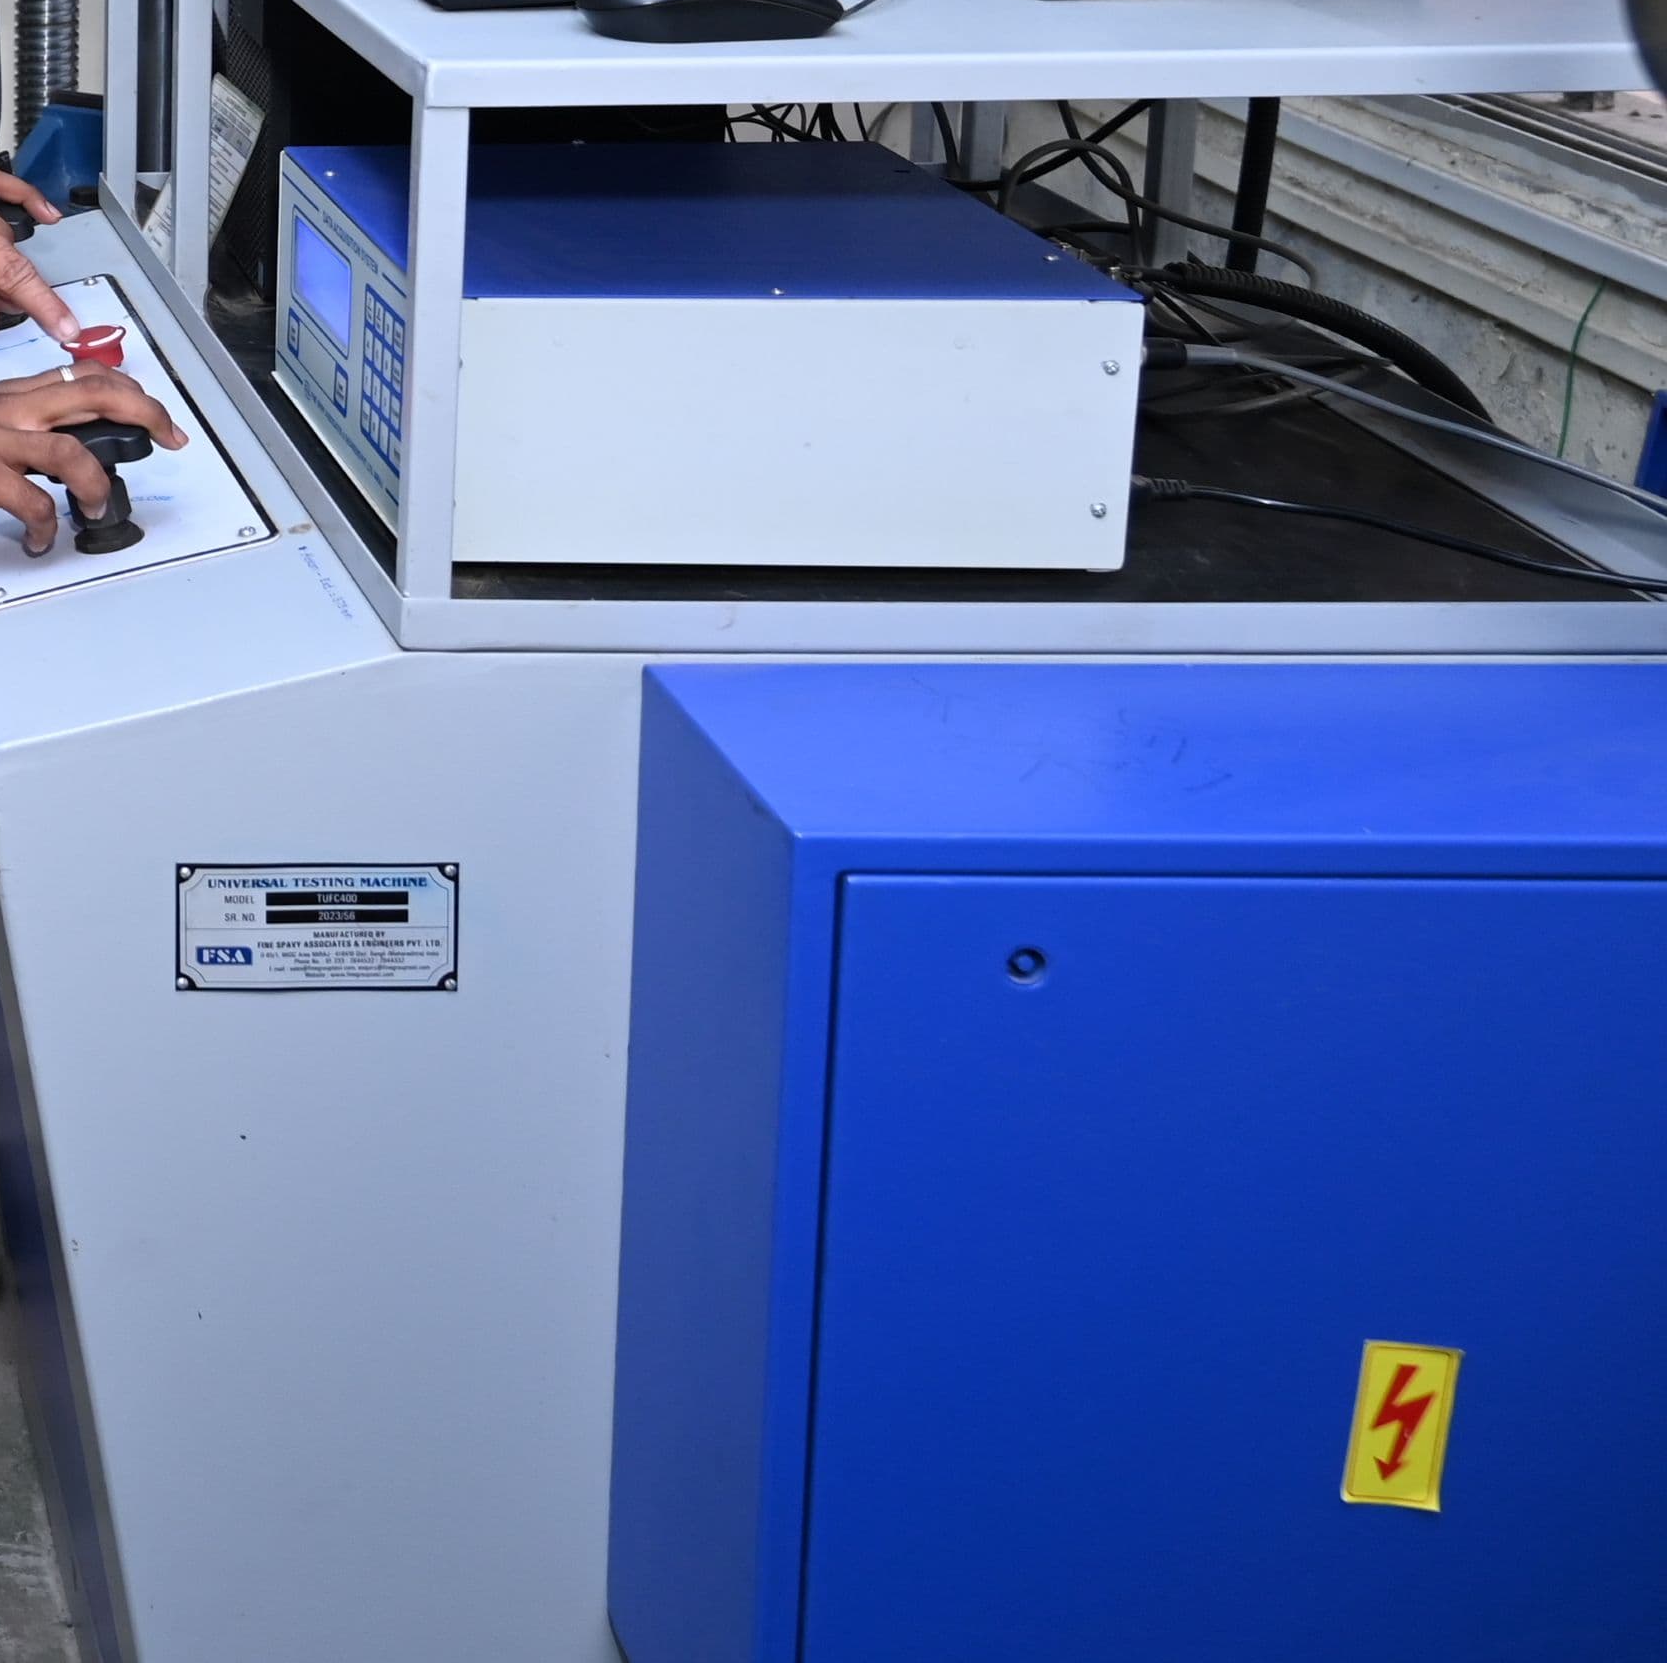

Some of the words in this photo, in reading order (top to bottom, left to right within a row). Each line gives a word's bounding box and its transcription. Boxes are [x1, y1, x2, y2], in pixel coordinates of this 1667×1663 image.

[208, 878, 288, 889] UNIVERSAL
[294, 877, 355, 888] TESTING
[361, 876, 428, 887] MACHINE
[224, 895, 255, 905] MODEL
[202, 949, 246, 963] FSA
